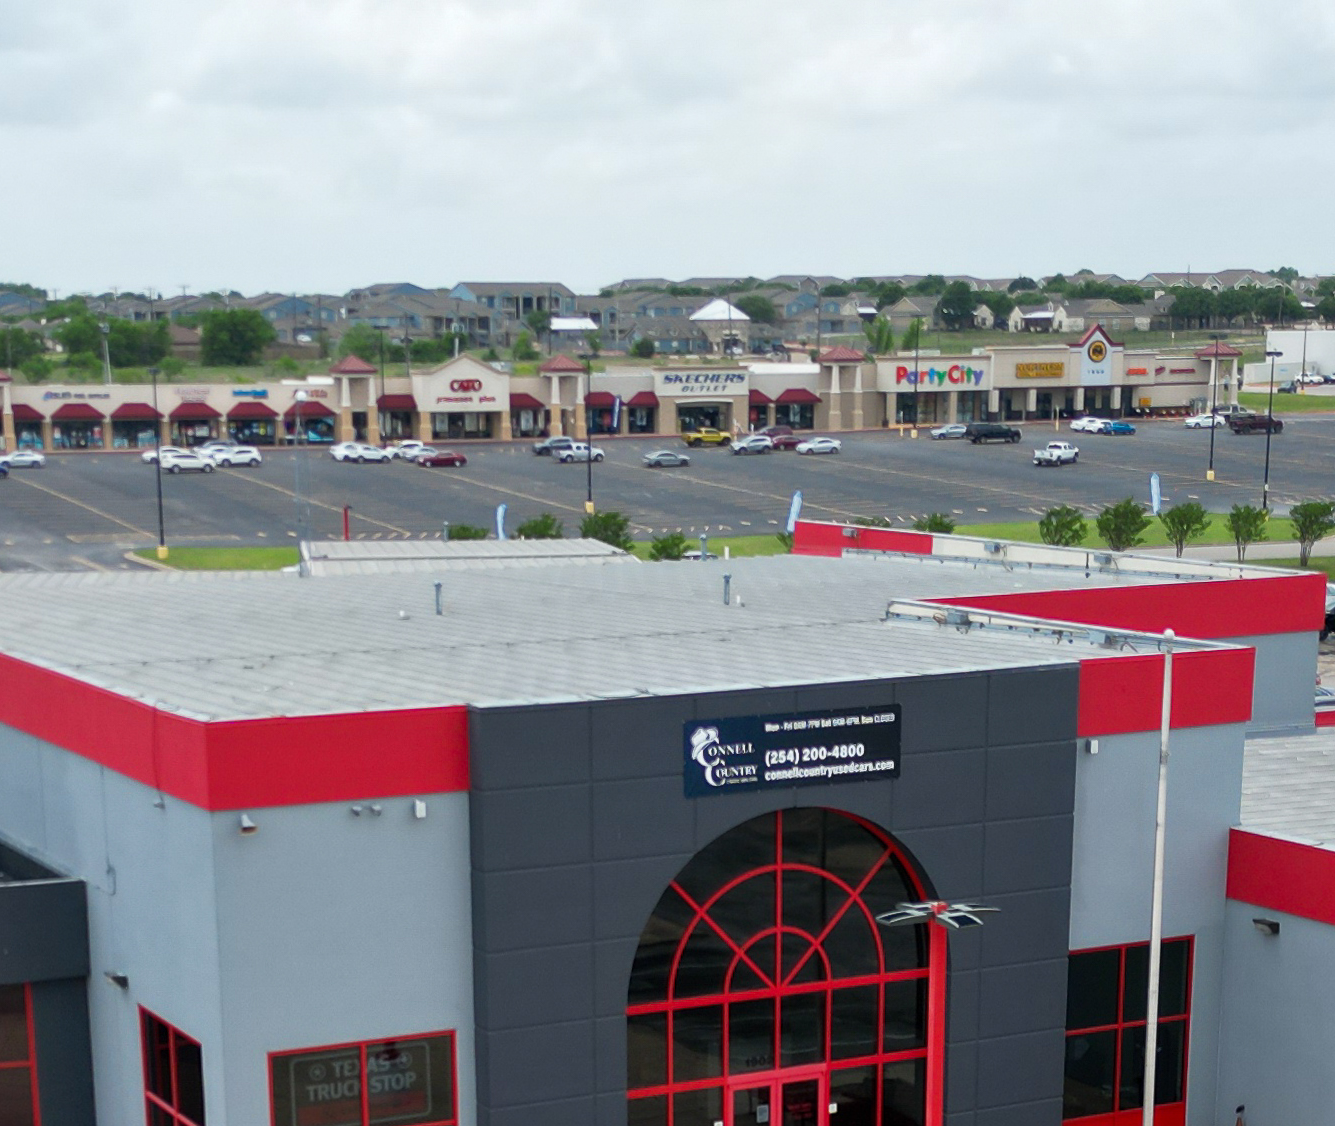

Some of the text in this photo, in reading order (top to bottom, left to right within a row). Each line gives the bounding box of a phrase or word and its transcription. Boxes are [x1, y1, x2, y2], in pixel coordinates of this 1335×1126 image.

[663, 373, 746, 385] SKECHERS
[681, 385, 728, 393] OUTLET
[765, 743, 865, 768] (254) 200-4800
[705, 760, 759, 787] COUNTRY
[765, 759, 895, 781] connellcountryusedcars.com
[332, 1054, 391, 1078] TEAS
[307, 1072, 417, 1102] TRUC STOP
